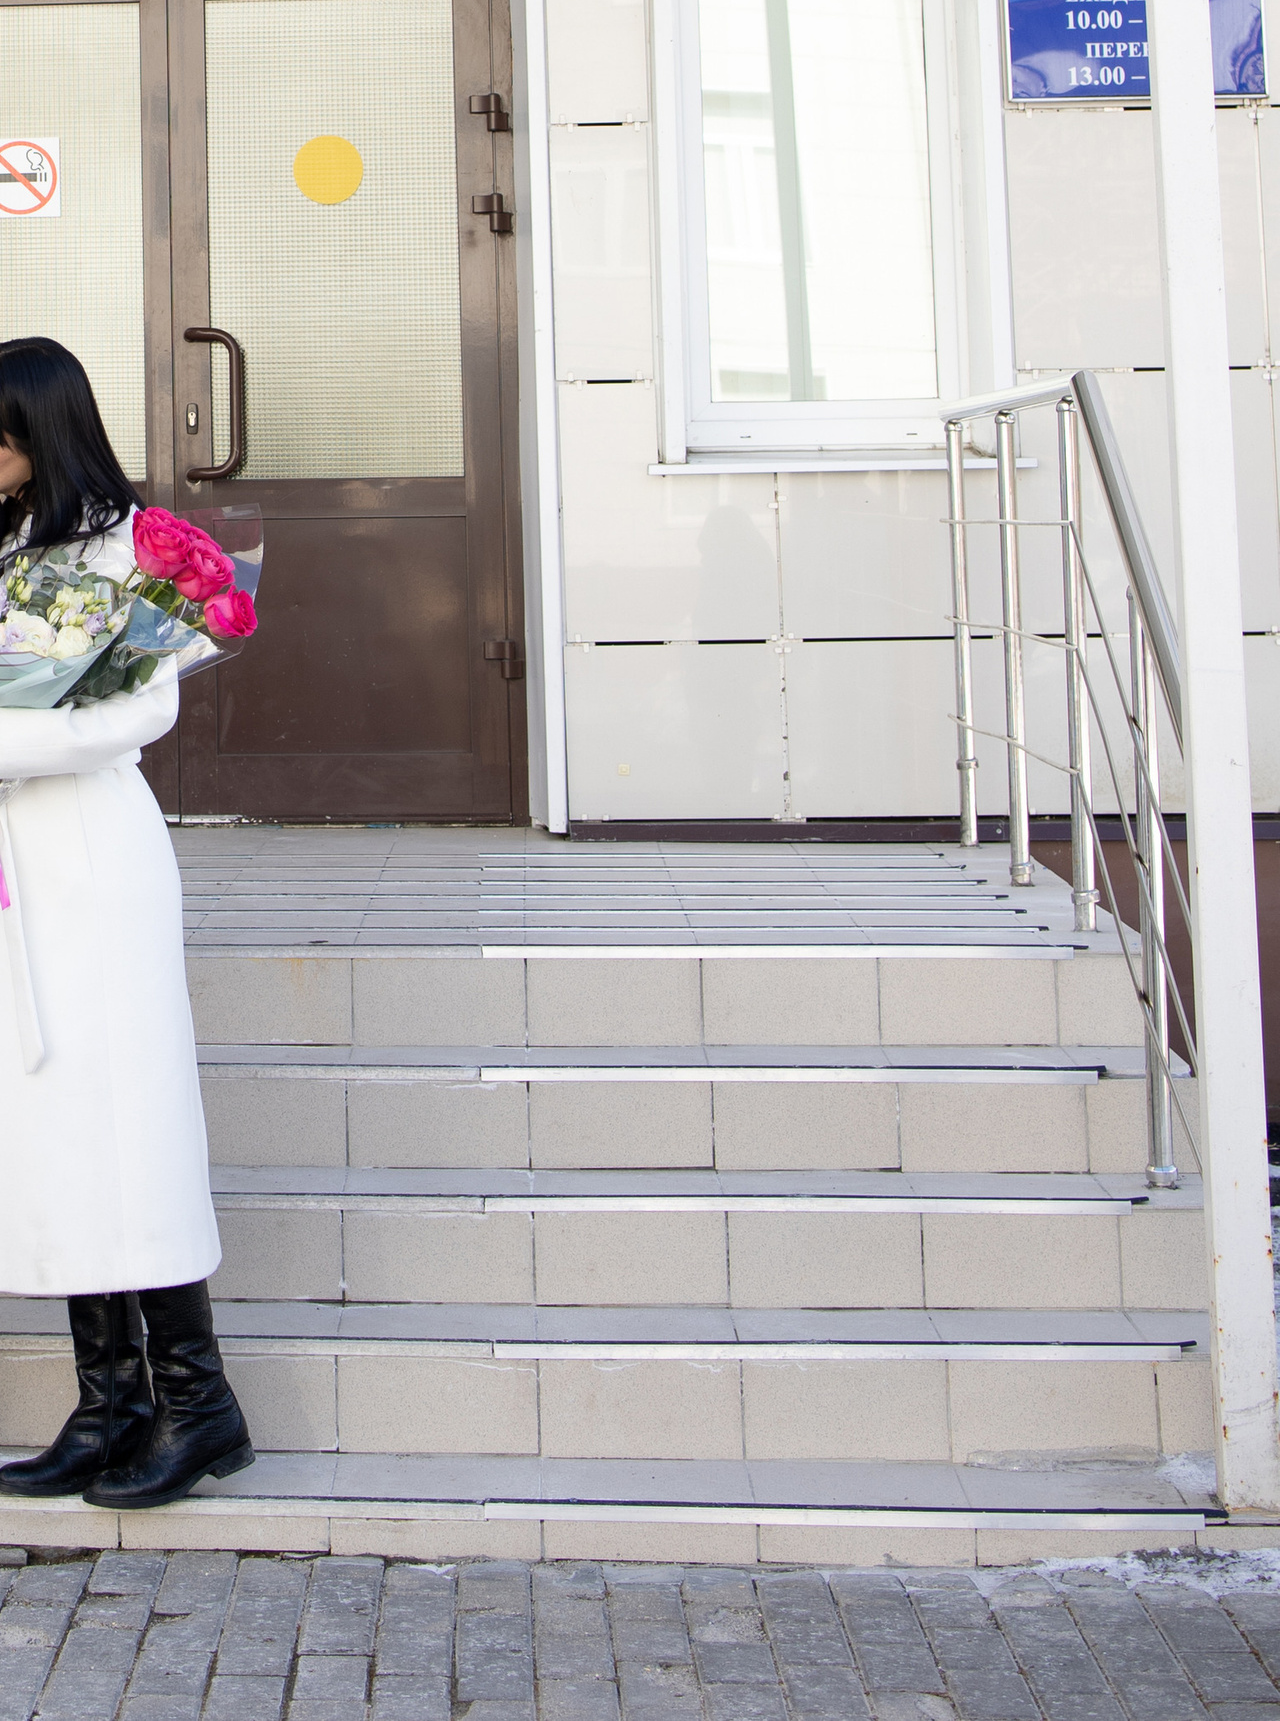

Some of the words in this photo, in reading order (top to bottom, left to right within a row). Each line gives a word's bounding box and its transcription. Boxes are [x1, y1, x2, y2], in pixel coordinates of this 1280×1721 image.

[1066, 10, 1122, 29] 10.00
[1086, 42, 1149, 58] ПЕРЕ
[1069, 66, 1125, 85] 13.00
